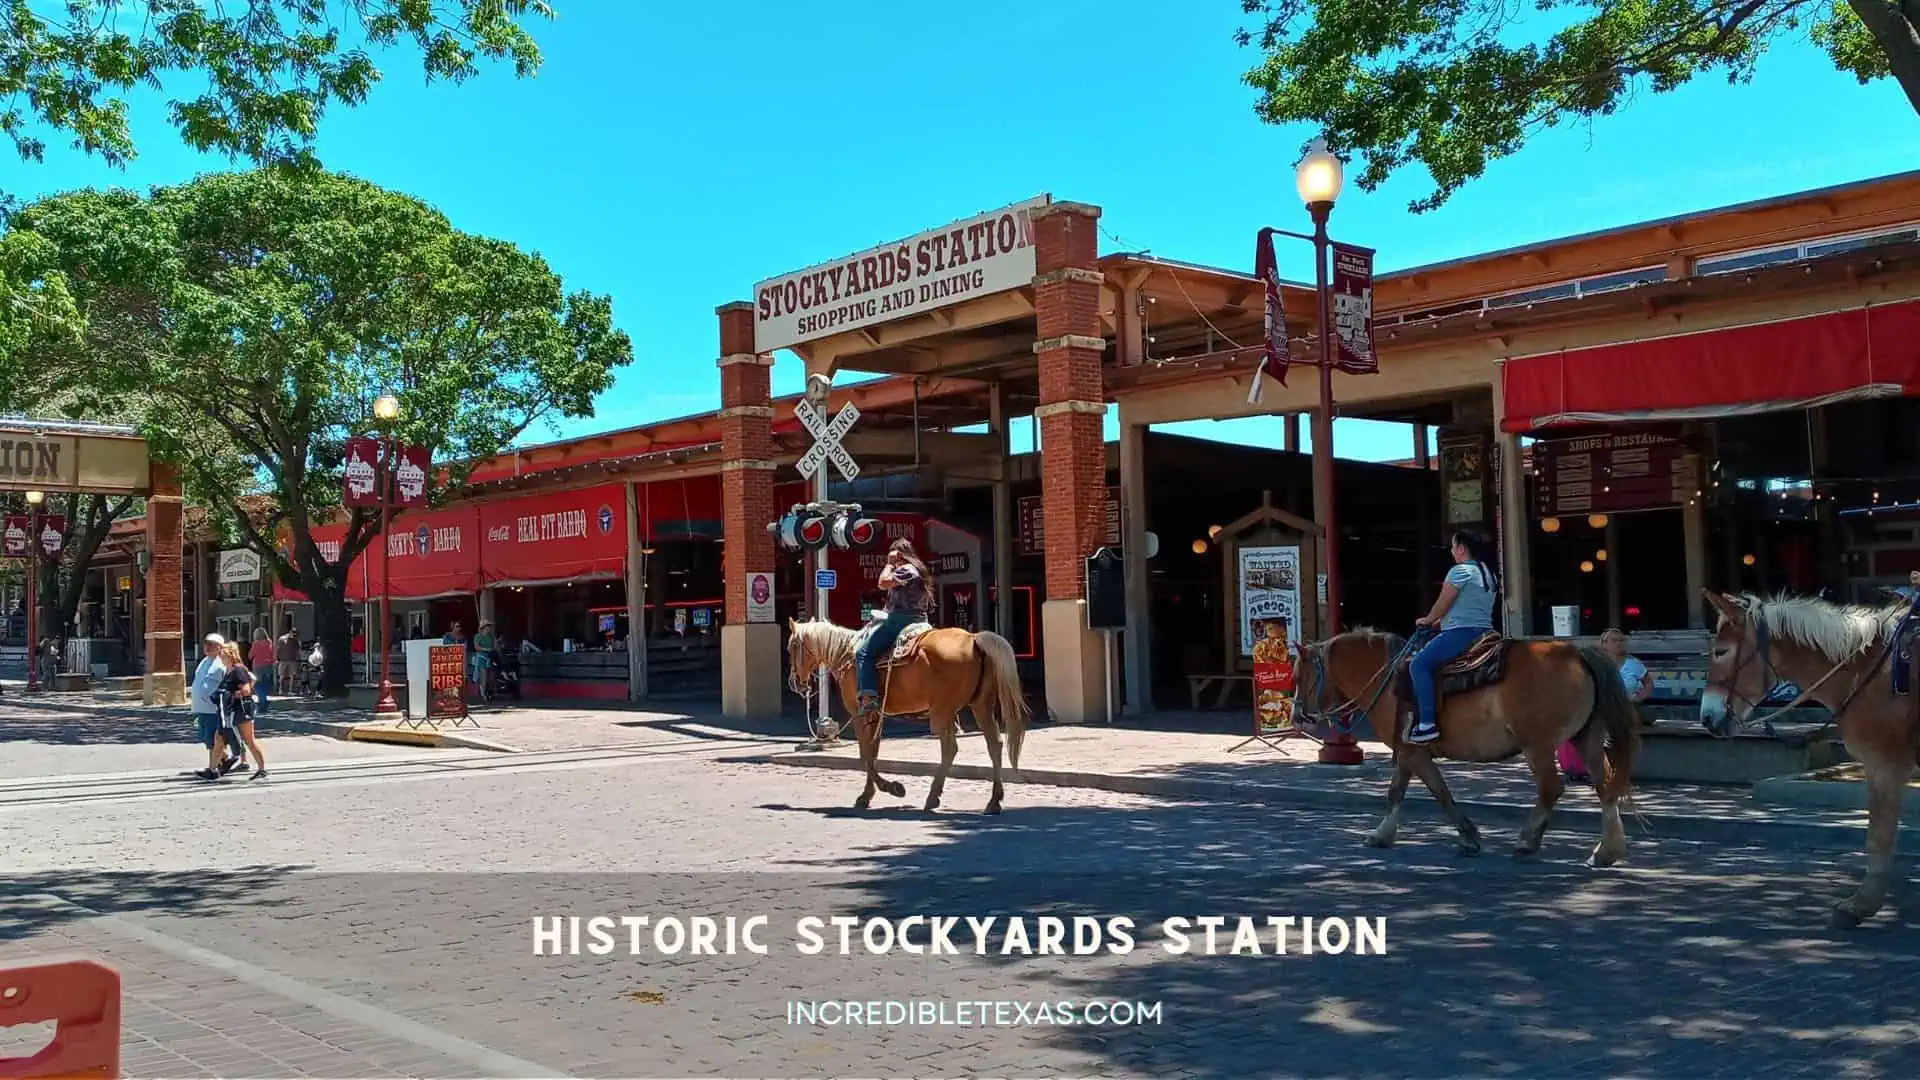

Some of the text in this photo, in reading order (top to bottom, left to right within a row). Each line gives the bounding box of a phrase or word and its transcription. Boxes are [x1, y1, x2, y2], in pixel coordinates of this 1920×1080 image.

[759, 210, 1034, 321] STOCKYARDS STATION
[798, 269, 984, 335] SHOPPING AND DINING
[799, 403, 857, 477] RAIL ROAD
[802, 408, 855, 473] CROSSING
[517, 516, 539, 542] REAL
[541, 513, 556, 540] PIT
[432, 675, 463, 689] RIBS
